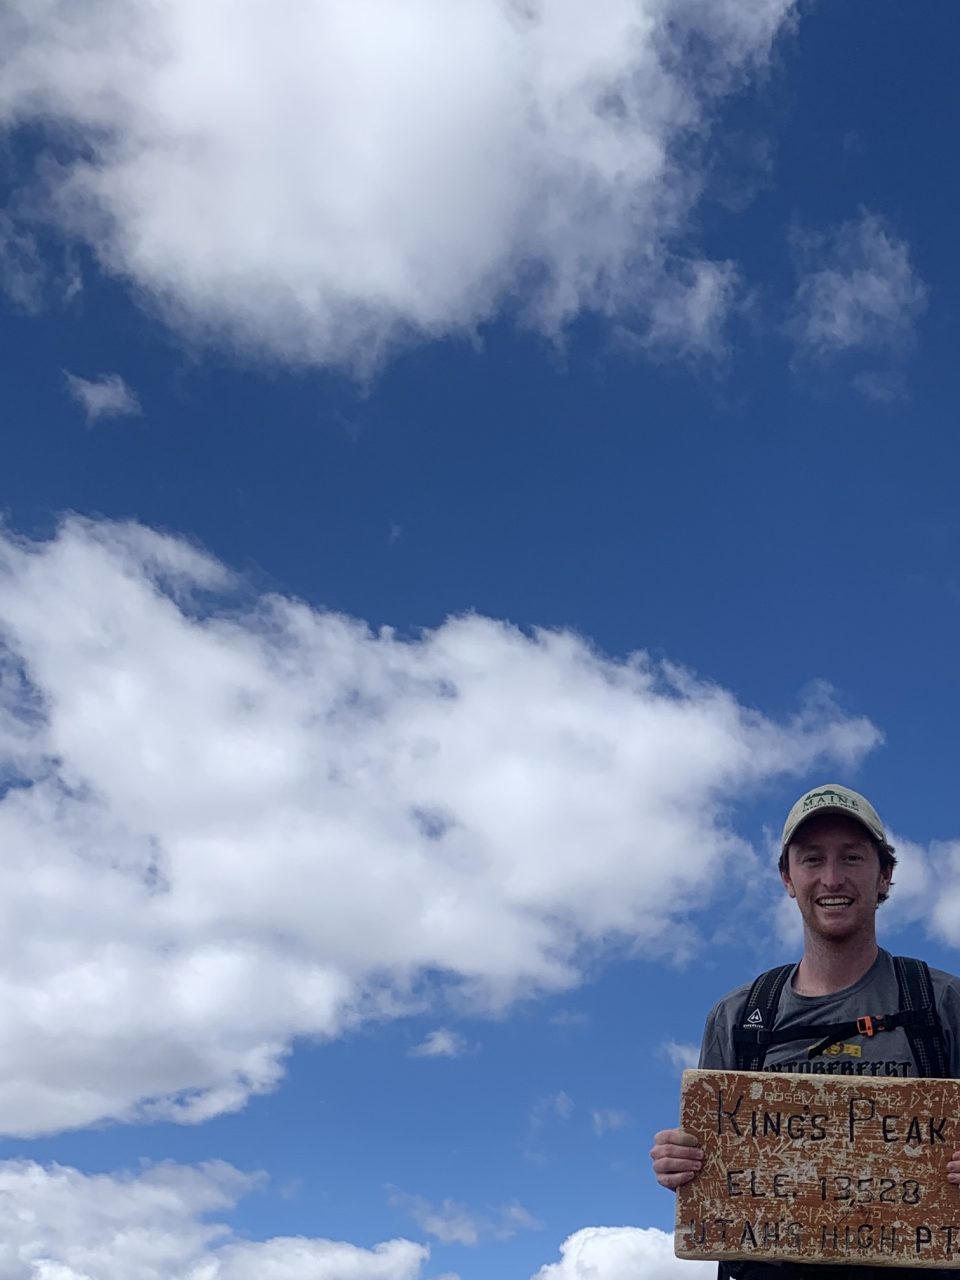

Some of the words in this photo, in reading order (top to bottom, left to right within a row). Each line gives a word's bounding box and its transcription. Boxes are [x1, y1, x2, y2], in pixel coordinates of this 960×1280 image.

[803, 796, 858, 808] MAINE
[849, 1098, 947, 1145] PEAK
[821, 1224, 896, 1253] HIGH
